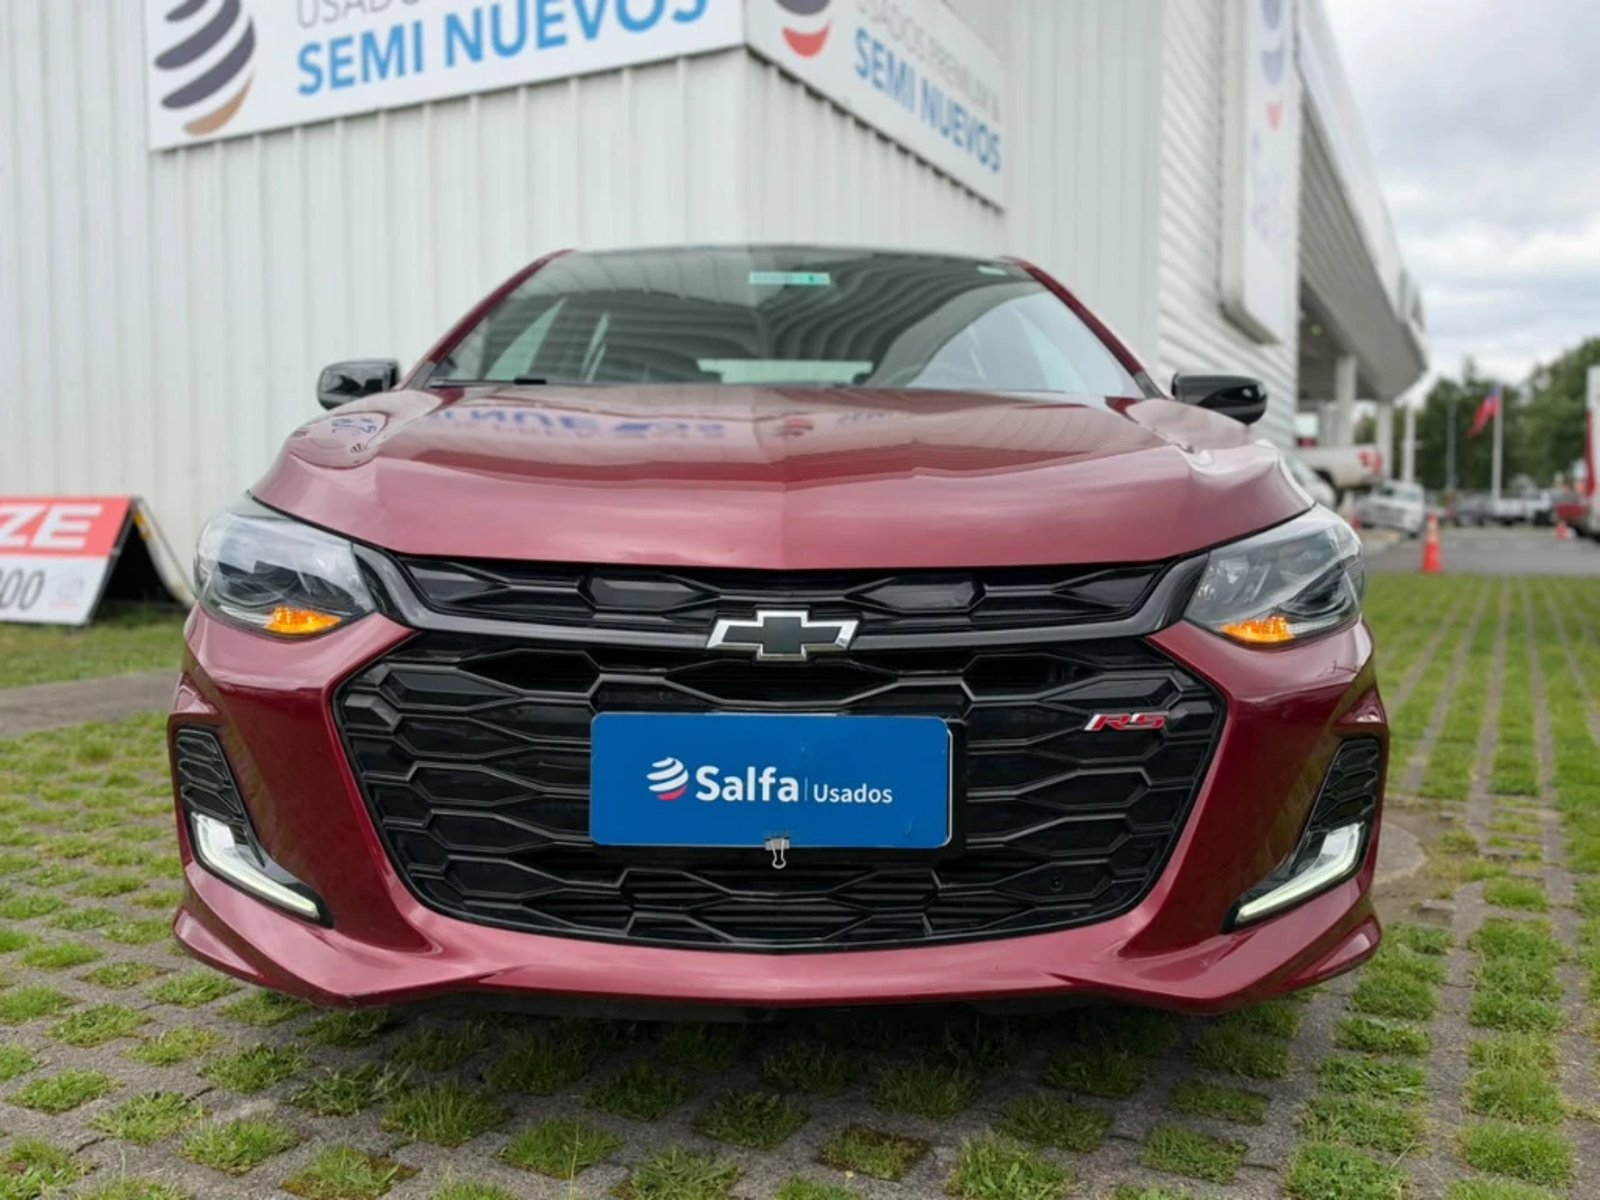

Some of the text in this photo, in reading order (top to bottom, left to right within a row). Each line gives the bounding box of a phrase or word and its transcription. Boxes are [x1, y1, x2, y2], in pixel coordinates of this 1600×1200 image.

[298, 20, 423, 96] SEMI
[855, 26, 1000, 174] SEMI NUEVOS
[1084, 711, 1169, 732] RS
[695, 765, 893, 804] Salfa Usados
